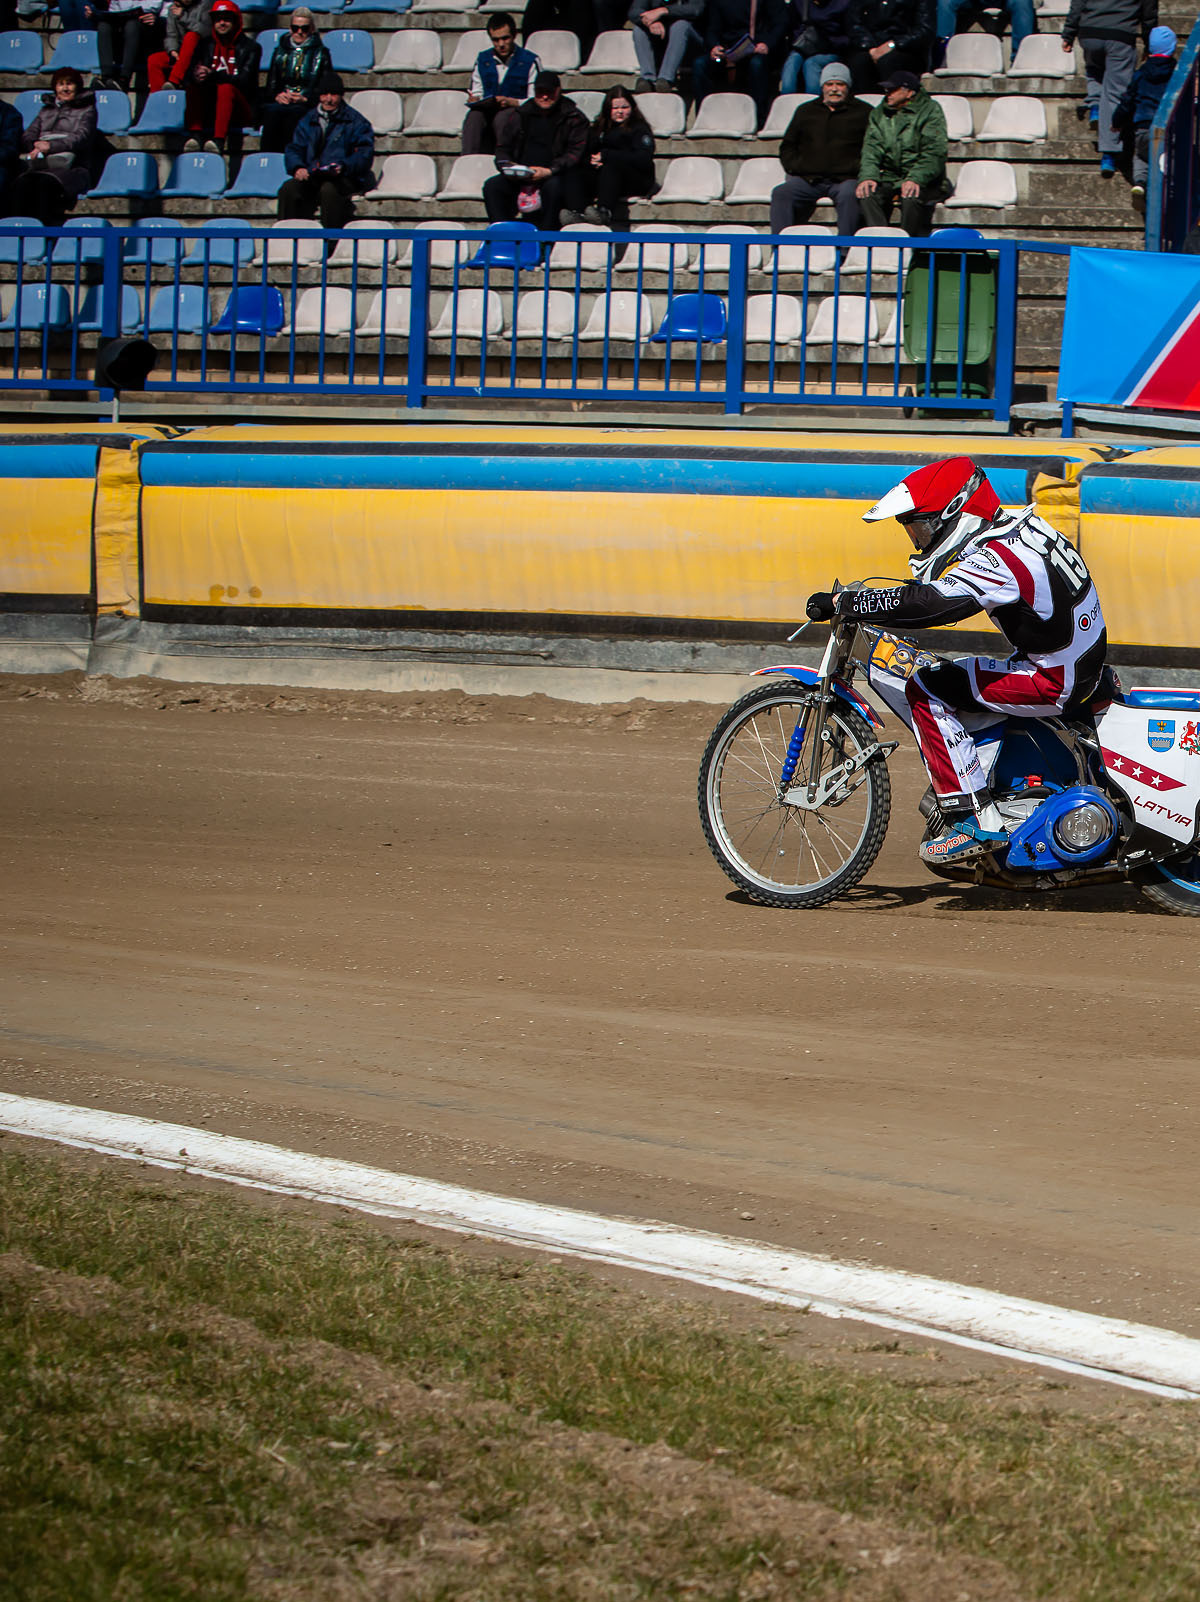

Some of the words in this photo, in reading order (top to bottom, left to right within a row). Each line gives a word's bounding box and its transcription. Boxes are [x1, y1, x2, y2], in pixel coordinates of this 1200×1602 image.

[77, 34, 88, 44] 15
[193, 158, 205, 168] 12
[1050, 536, 1088, 590] 15
[1133, 795, 1193, 827] LATVIA
